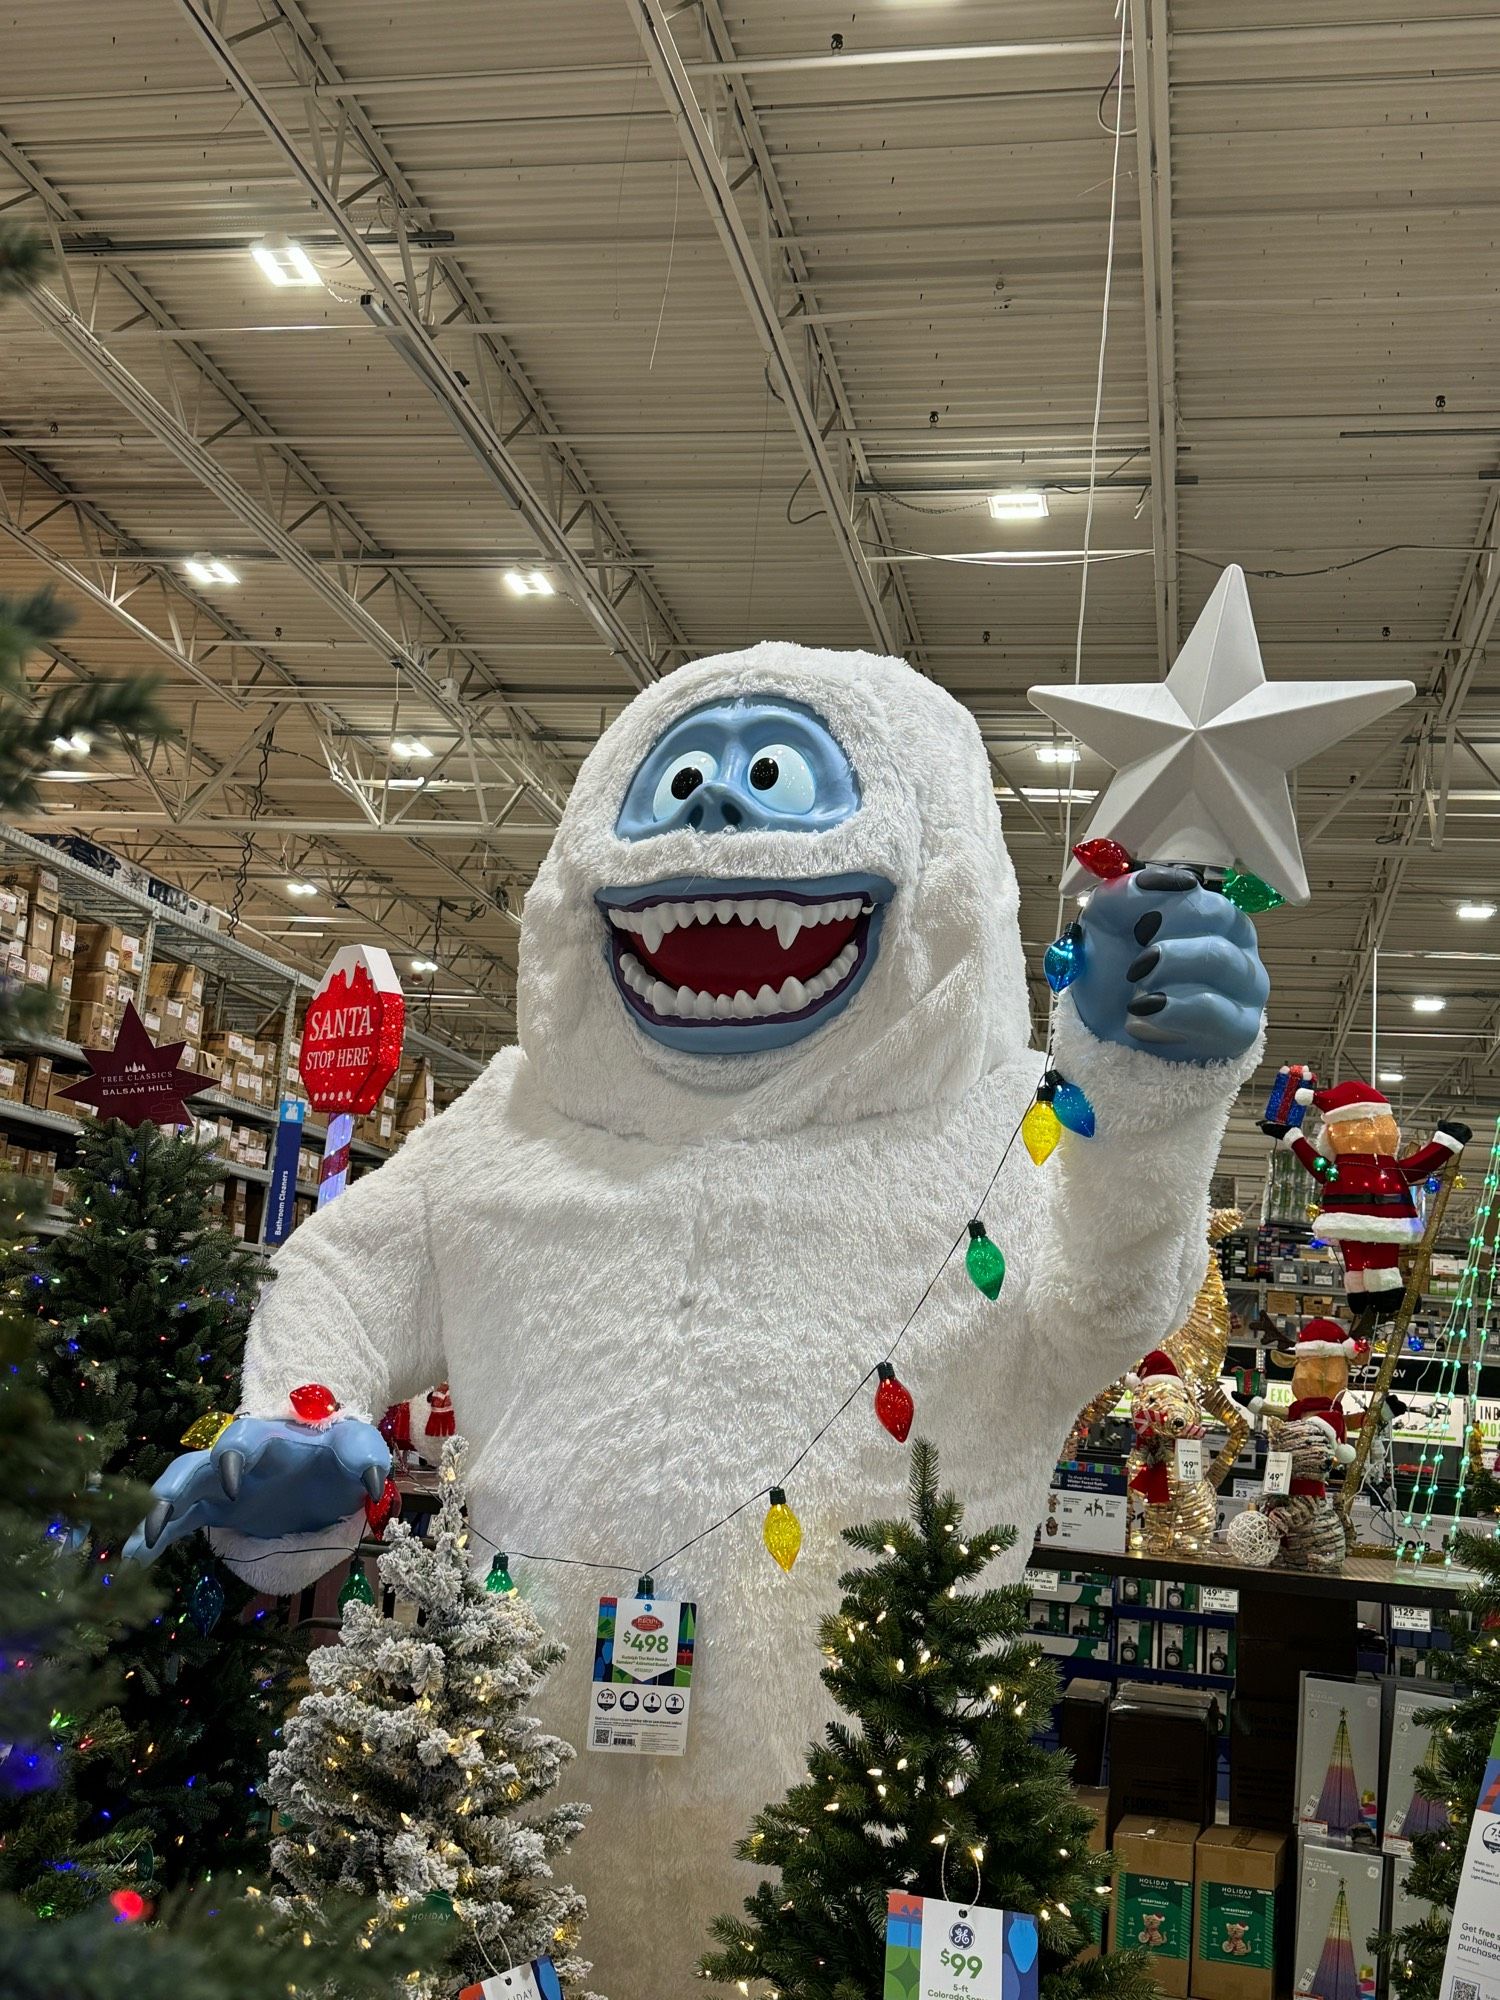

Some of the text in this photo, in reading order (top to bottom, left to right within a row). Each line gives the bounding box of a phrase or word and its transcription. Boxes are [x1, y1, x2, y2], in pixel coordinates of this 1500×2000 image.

[309, 1005, 372, 1042] SANTA
[305, 1046, 370, 1071] STOP HERE
[101, 1071, 173, 1083] TREE CLASSICS
[102, 1087, 145, 1096] BALSAM
[148, 1083, 173, 1092] HILL
[274, 1170, 289, 1236] Bathroom Cleaners
[623, 1630, 669, 1654] $498
[600, 1692, 614, 1700] 9.75
[1139, 1878, 1169, 1888] HOLIDAY
[1221, 1887, 1253, 1896] HOLIDAY
[411, 1912, 450, 1921] HOLIDAY
[1462, 1922, 1477, 1934] Get
[1479, 1927, 1496, 1939] free
[1460, 1933, 1470, 1941] on
[940, 1948, 983, 1979] $99
[953, 1983, 969, 1993] 5-ft
[927, 1989, 965, 2000] Colorado
